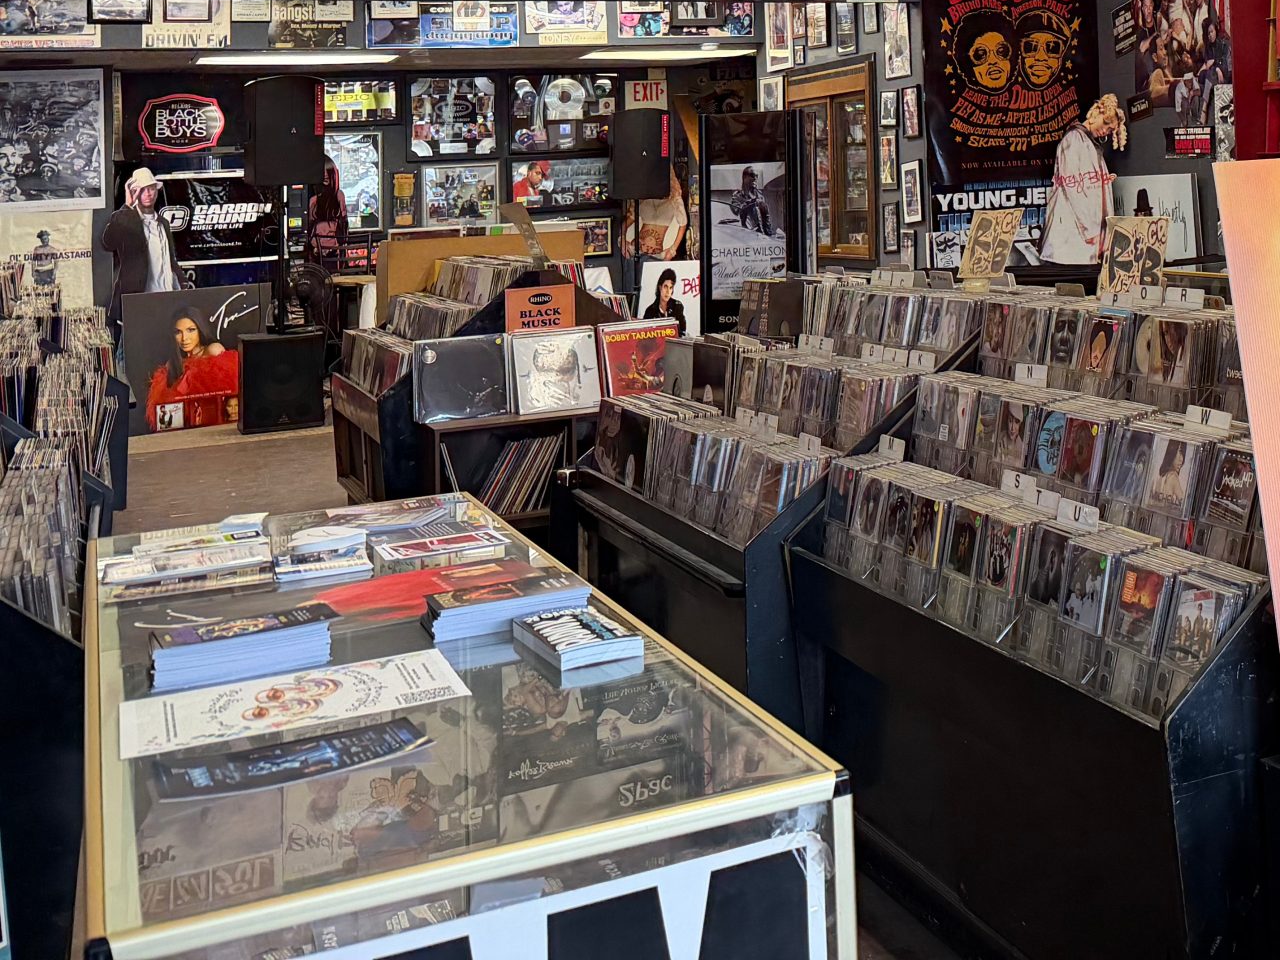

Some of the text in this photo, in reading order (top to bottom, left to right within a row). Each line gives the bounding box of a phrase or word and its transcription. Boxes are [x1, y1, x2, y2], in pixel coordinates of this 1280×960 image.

[947, 0, 981, 25] BRUNO
[330, 93, 369, 102] EPIC
[634, 82, 660, 102] EXIT
[962, 87, 989, 107] LEAVE
[156, 109, 206, 119] BLACK
[950, 97, 1060, 125] FLY AFTER LAST
[156, 126, 207, 138] BOYS
[1009, 136, 1028, 152] 777
[935, 189, 1017, 212] YOUNG
[194, 203, 272, 214] CARBON
[191, 212, 258, 225] SOUND
[712, 246, 786, 258] CHARLIE WILSON
[529, 295, 553, 303] RHINO
[1180, 288, 1188, 302] R
[520, 307, 561, 319] BLACK
[521, 318, 560, 329] MUSIC
[605, 332, 630, 342] BOBBY
[1026, 365, 1034, 379] N
[1199, 408, 1211, 425] W
[1014, 474, 1021, 489] S
[1073, 509, 1081, 522] U
